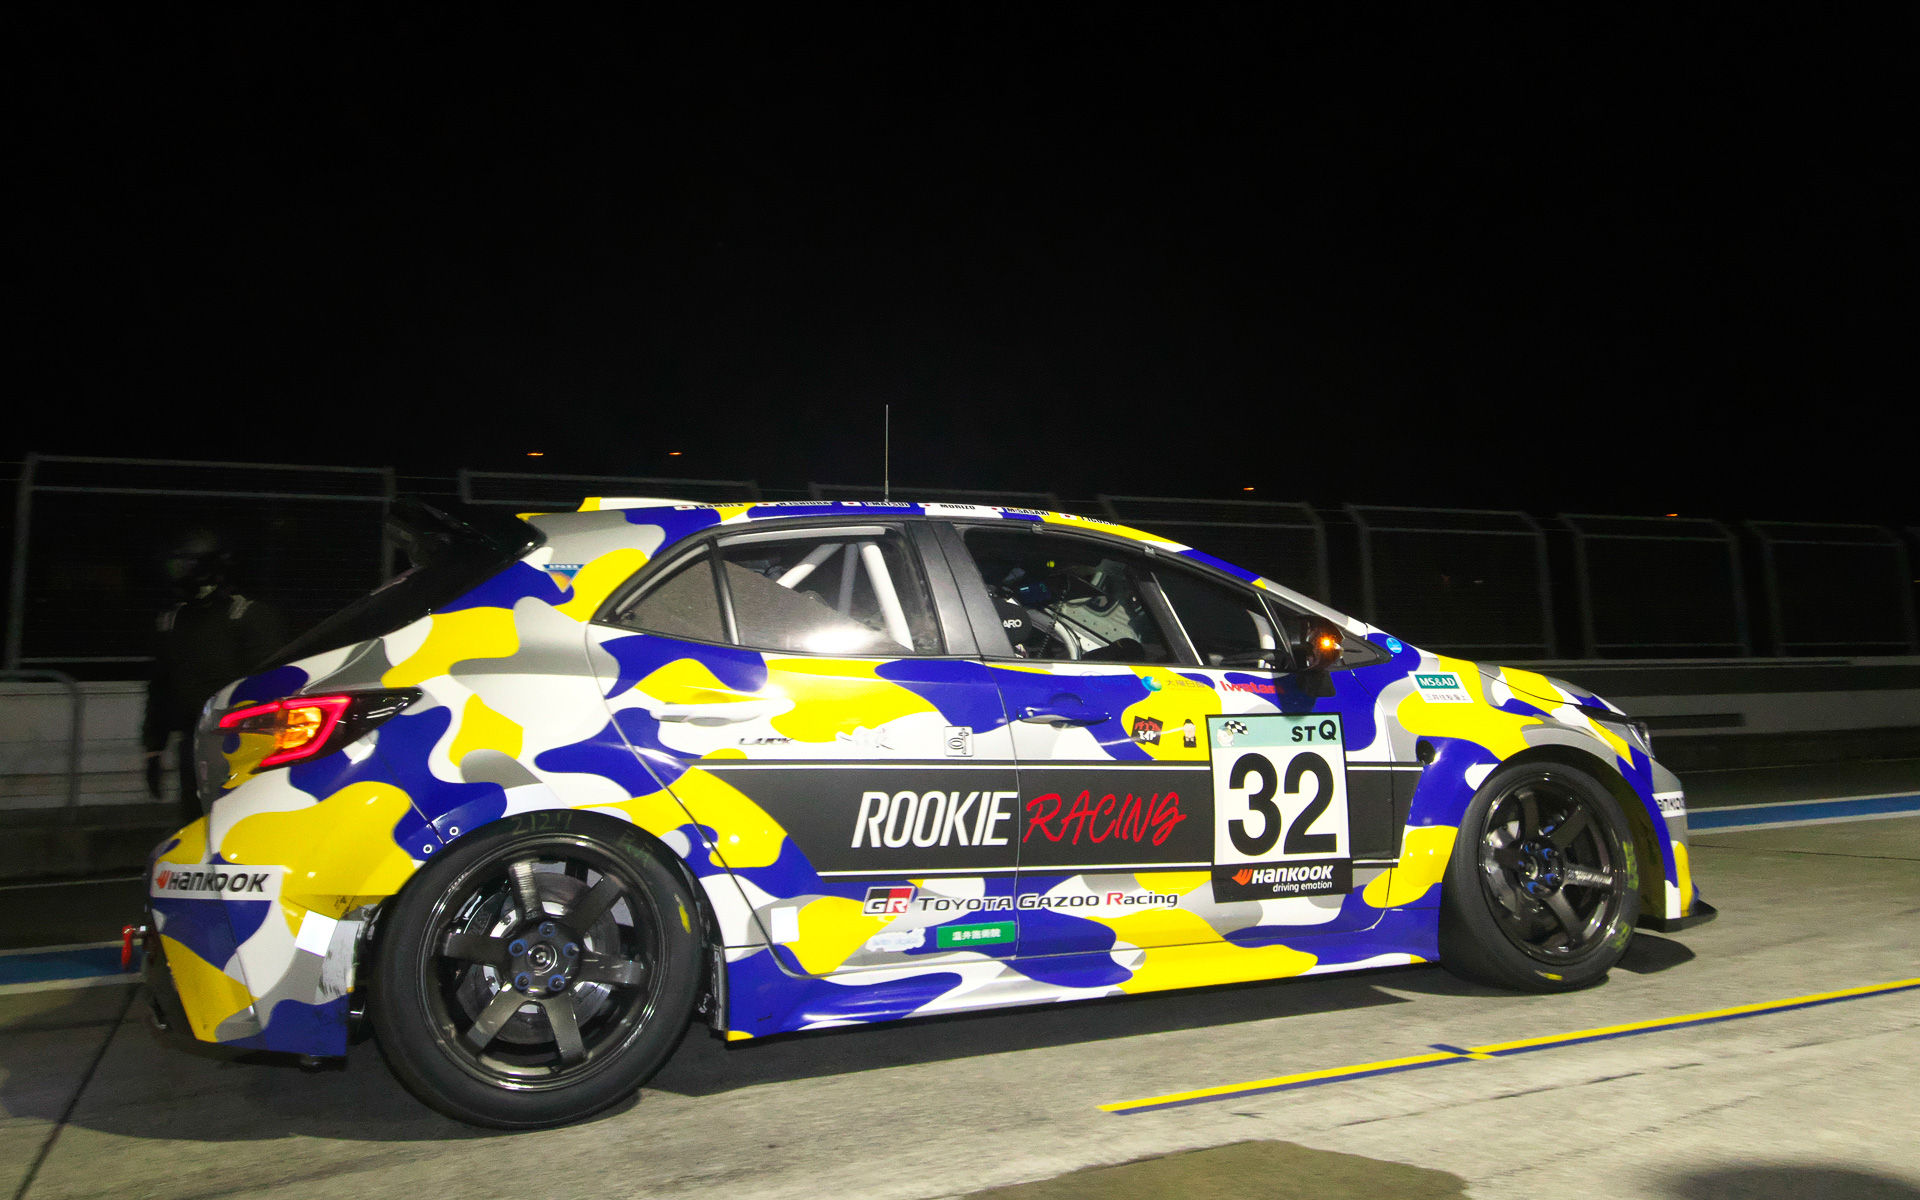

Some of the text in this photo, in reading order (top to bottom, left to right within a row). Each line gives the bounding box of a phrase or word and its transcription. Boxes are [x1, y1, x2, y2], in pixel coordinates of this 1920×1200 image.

[1003, 619, 1022, 628] ARO
[1418, 677, 1456, 686] MS&AD
[1228, 751, 1337, 857] 32
[851, 789, 1187, 848] ROOKIE RACING
[1272, 880, 1333, 893] driving emotion
[864, 891, 1180, 914] GR TOYOTA GAZOO Racing
